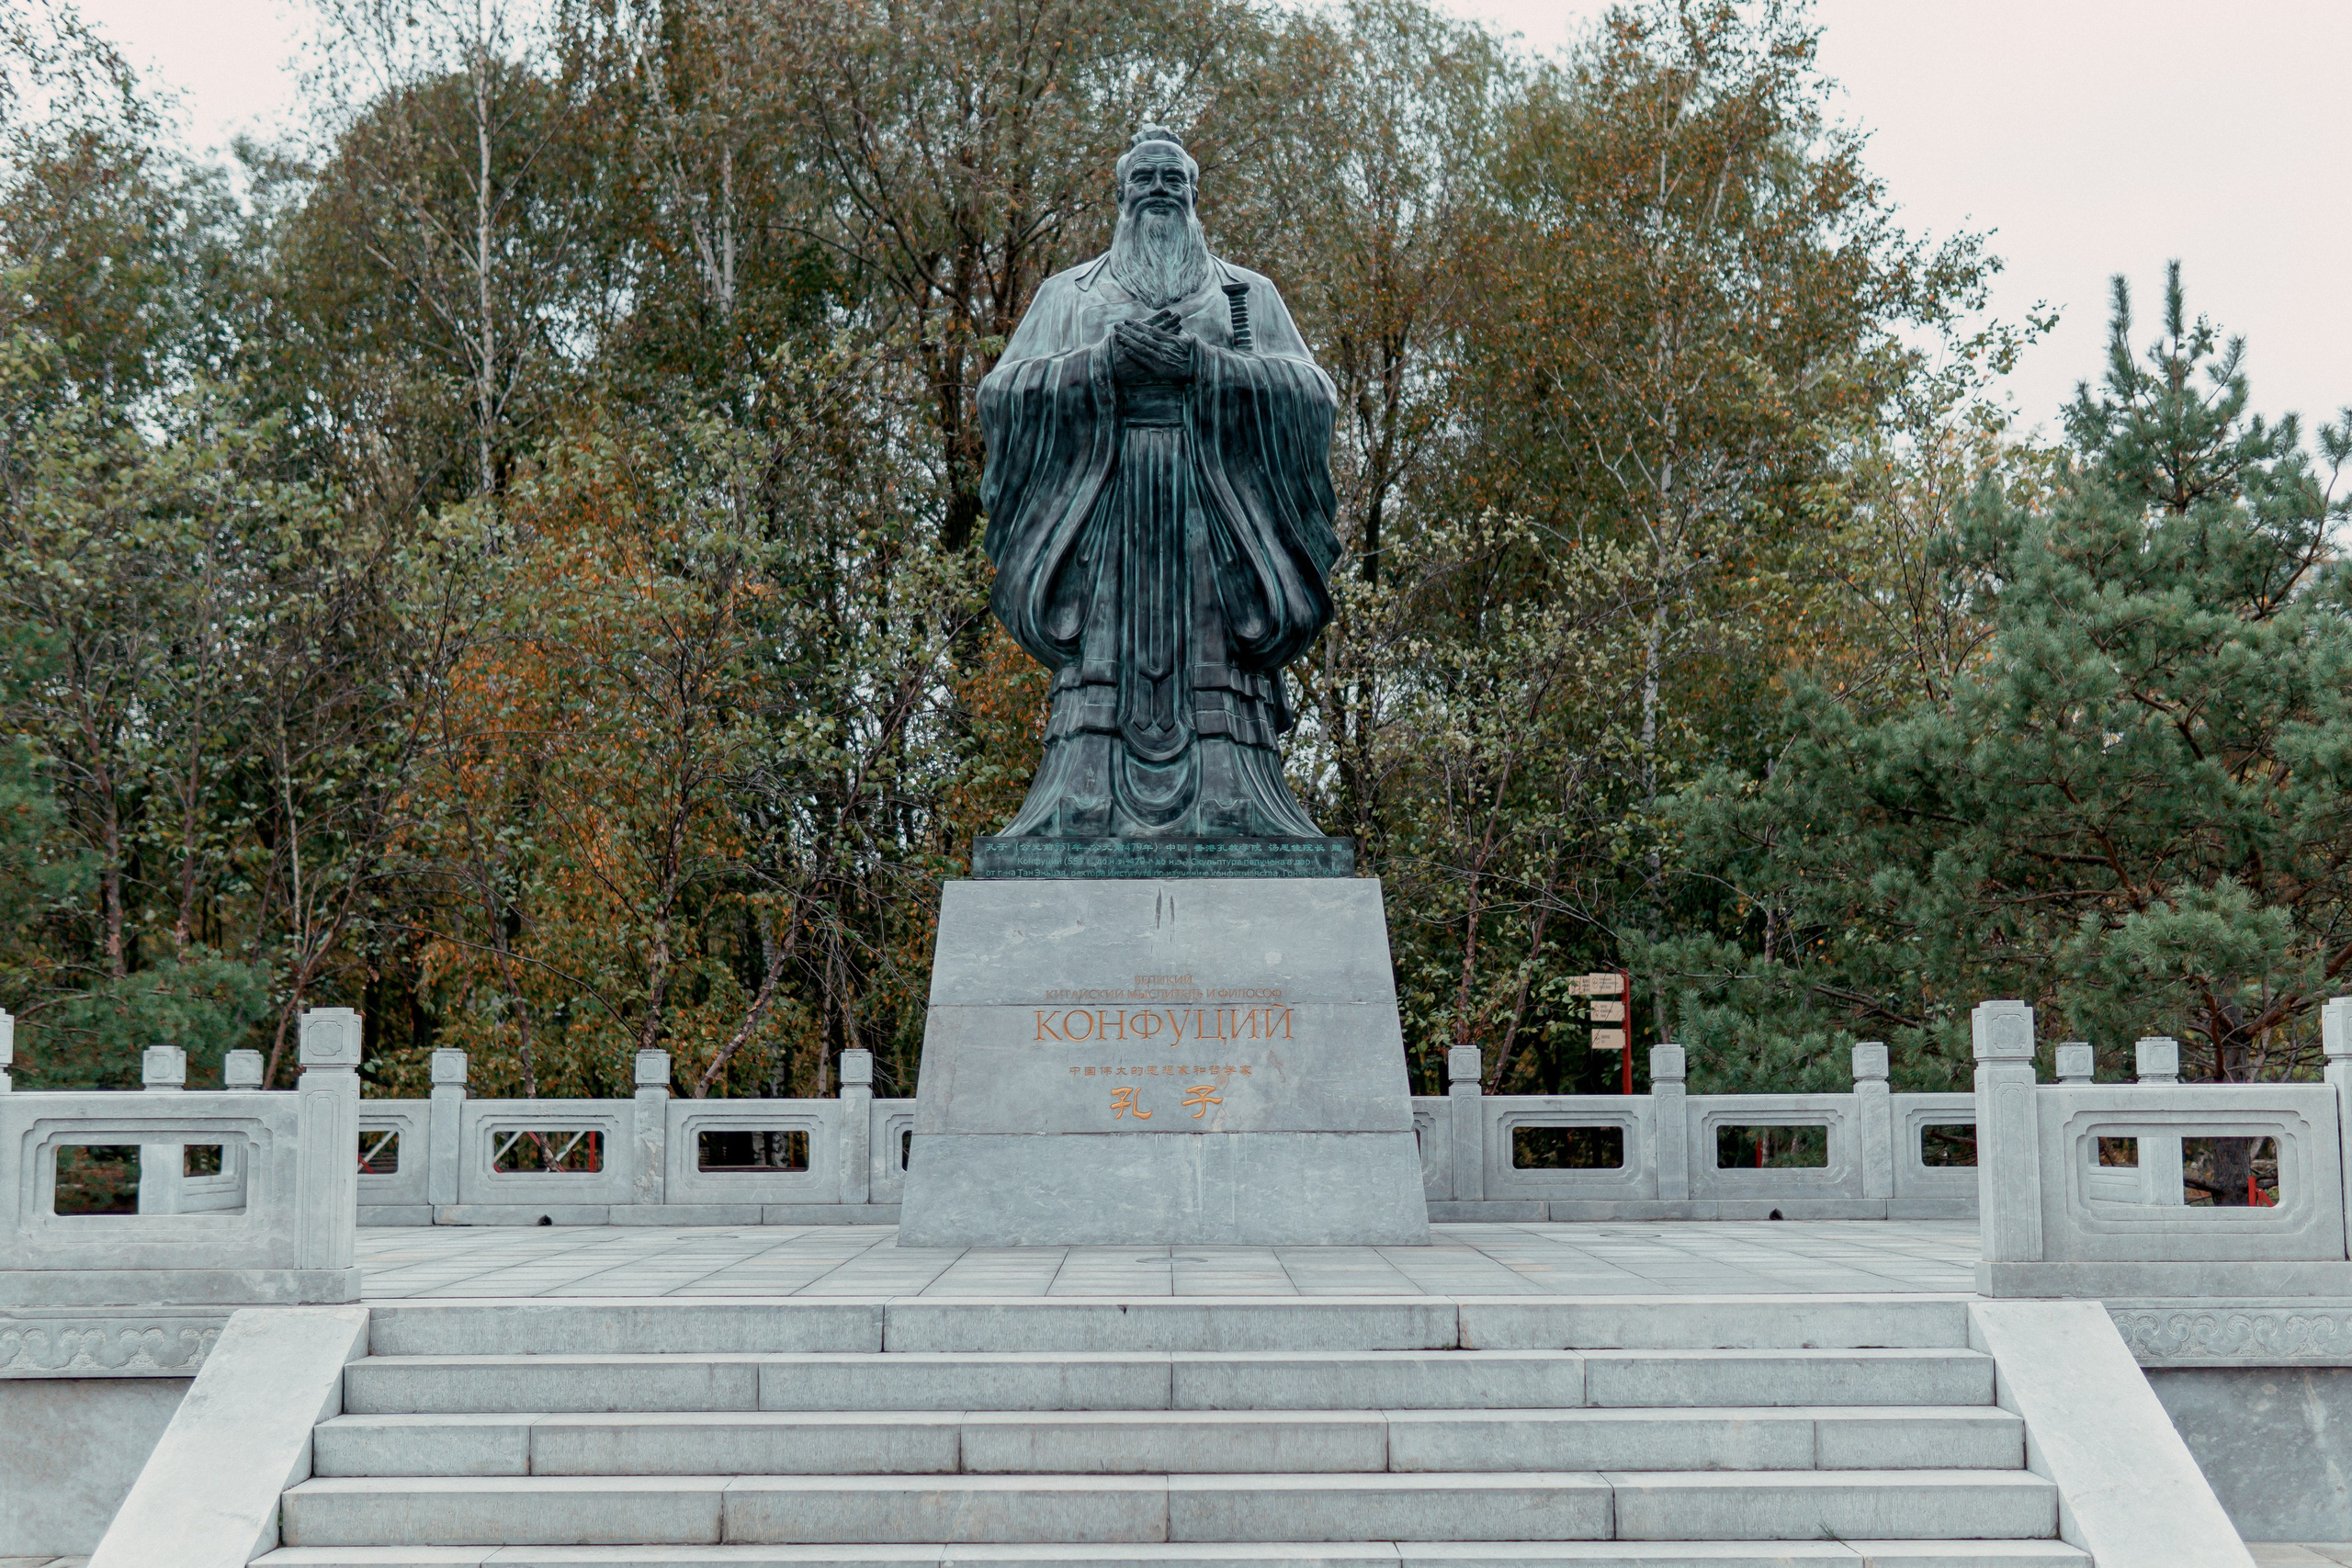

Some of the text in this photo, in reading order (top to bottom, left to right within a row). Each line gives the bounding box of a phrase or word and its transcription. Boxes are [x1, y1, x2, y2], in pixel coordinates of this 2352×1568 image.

[986, 842, 1008, 852] 孔子
[1166, 843, 1188, 852] 中国
[1017, 857, 1062, 865] Конфуций
[1191, 857, 1241, 866] Скульптура
[1017, 868, 1034, 876] Тан
[1107, 869, 1152, 877] Института
[1211, 870, 1281, 878] конфуцианства,
[1323, 868, 1340, 876] КНР
[1134, 974, 1193, 986] ВЕЛИКИЙ
[1046, 988, 1282, 1000] КИТАЙСКИЙ МЫСЛИТЕЛЬ И ФИЛОСОФ
[1034, 1003, 1295, 1047] КОНФУЦИЙ
[1069, 1066, 1252, 1076] 中国伟大的思想家和哲学家
[1110, 1085, 1224, 1120] 孔子
